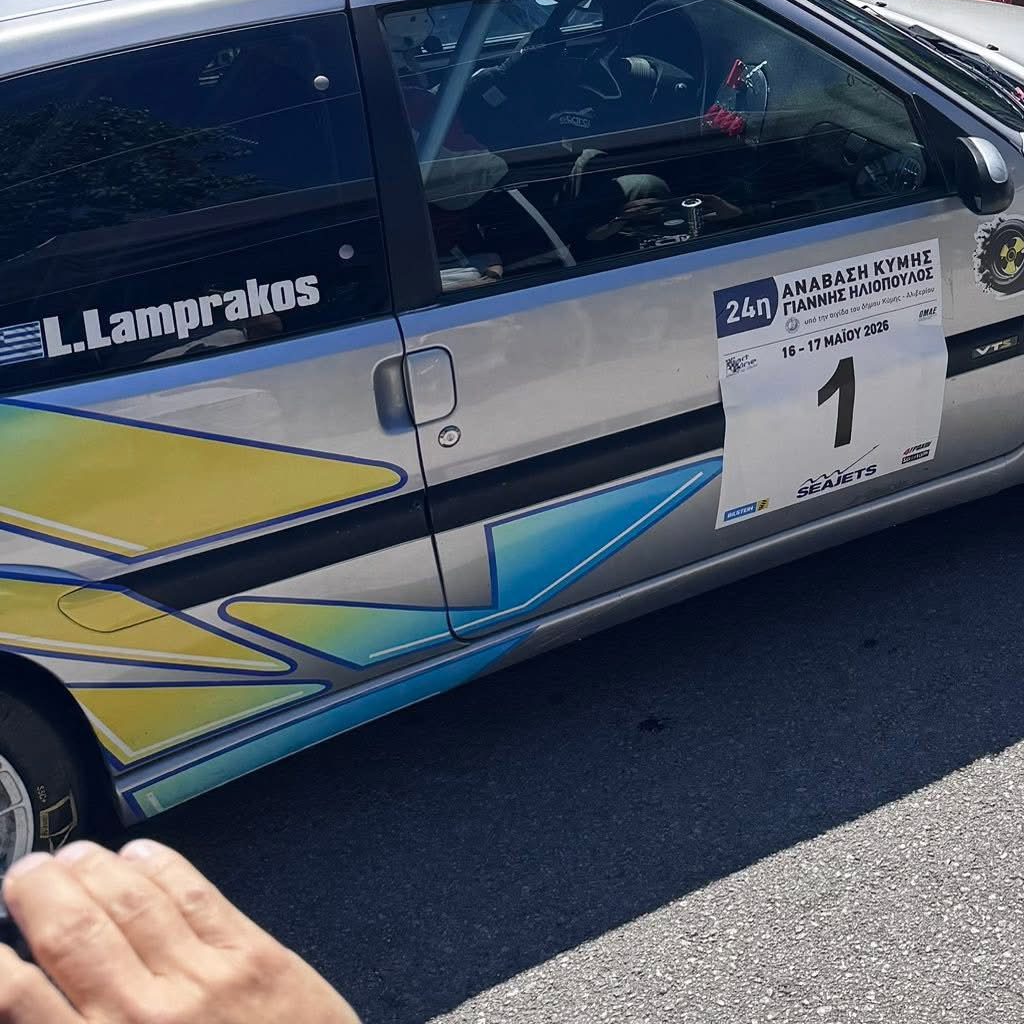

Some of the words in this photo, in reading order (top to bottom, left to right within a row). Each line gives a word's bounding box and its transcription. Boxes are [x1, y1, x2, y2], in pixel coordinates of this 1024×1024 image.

[781, 263, 869, 299] ΑΝΑΒΑΣΗ
[873, 249, 933, 275] ΚΥΜΗΣ
[783, 288, 847, 317] ΓΙΑΝΝΗΣ
[849, 267, 934, 300] ΗΛΙΟΠΟΥΛΟΣ
[42, 274, 321, 359] L.Lamprakos
[726, 294, 772, 325] 24η
[782, 344, 796, 359] 16
[807, 338, 821, 353] 17
[824, 326, 862, 350] ΜΑΪΟΥ
[863, 319, 890, 337] 2026
[975, 338, 1012, 356] VTS
[817, 356, 856, 449] 1
[796, 463, 878, 499] SEAJETS
